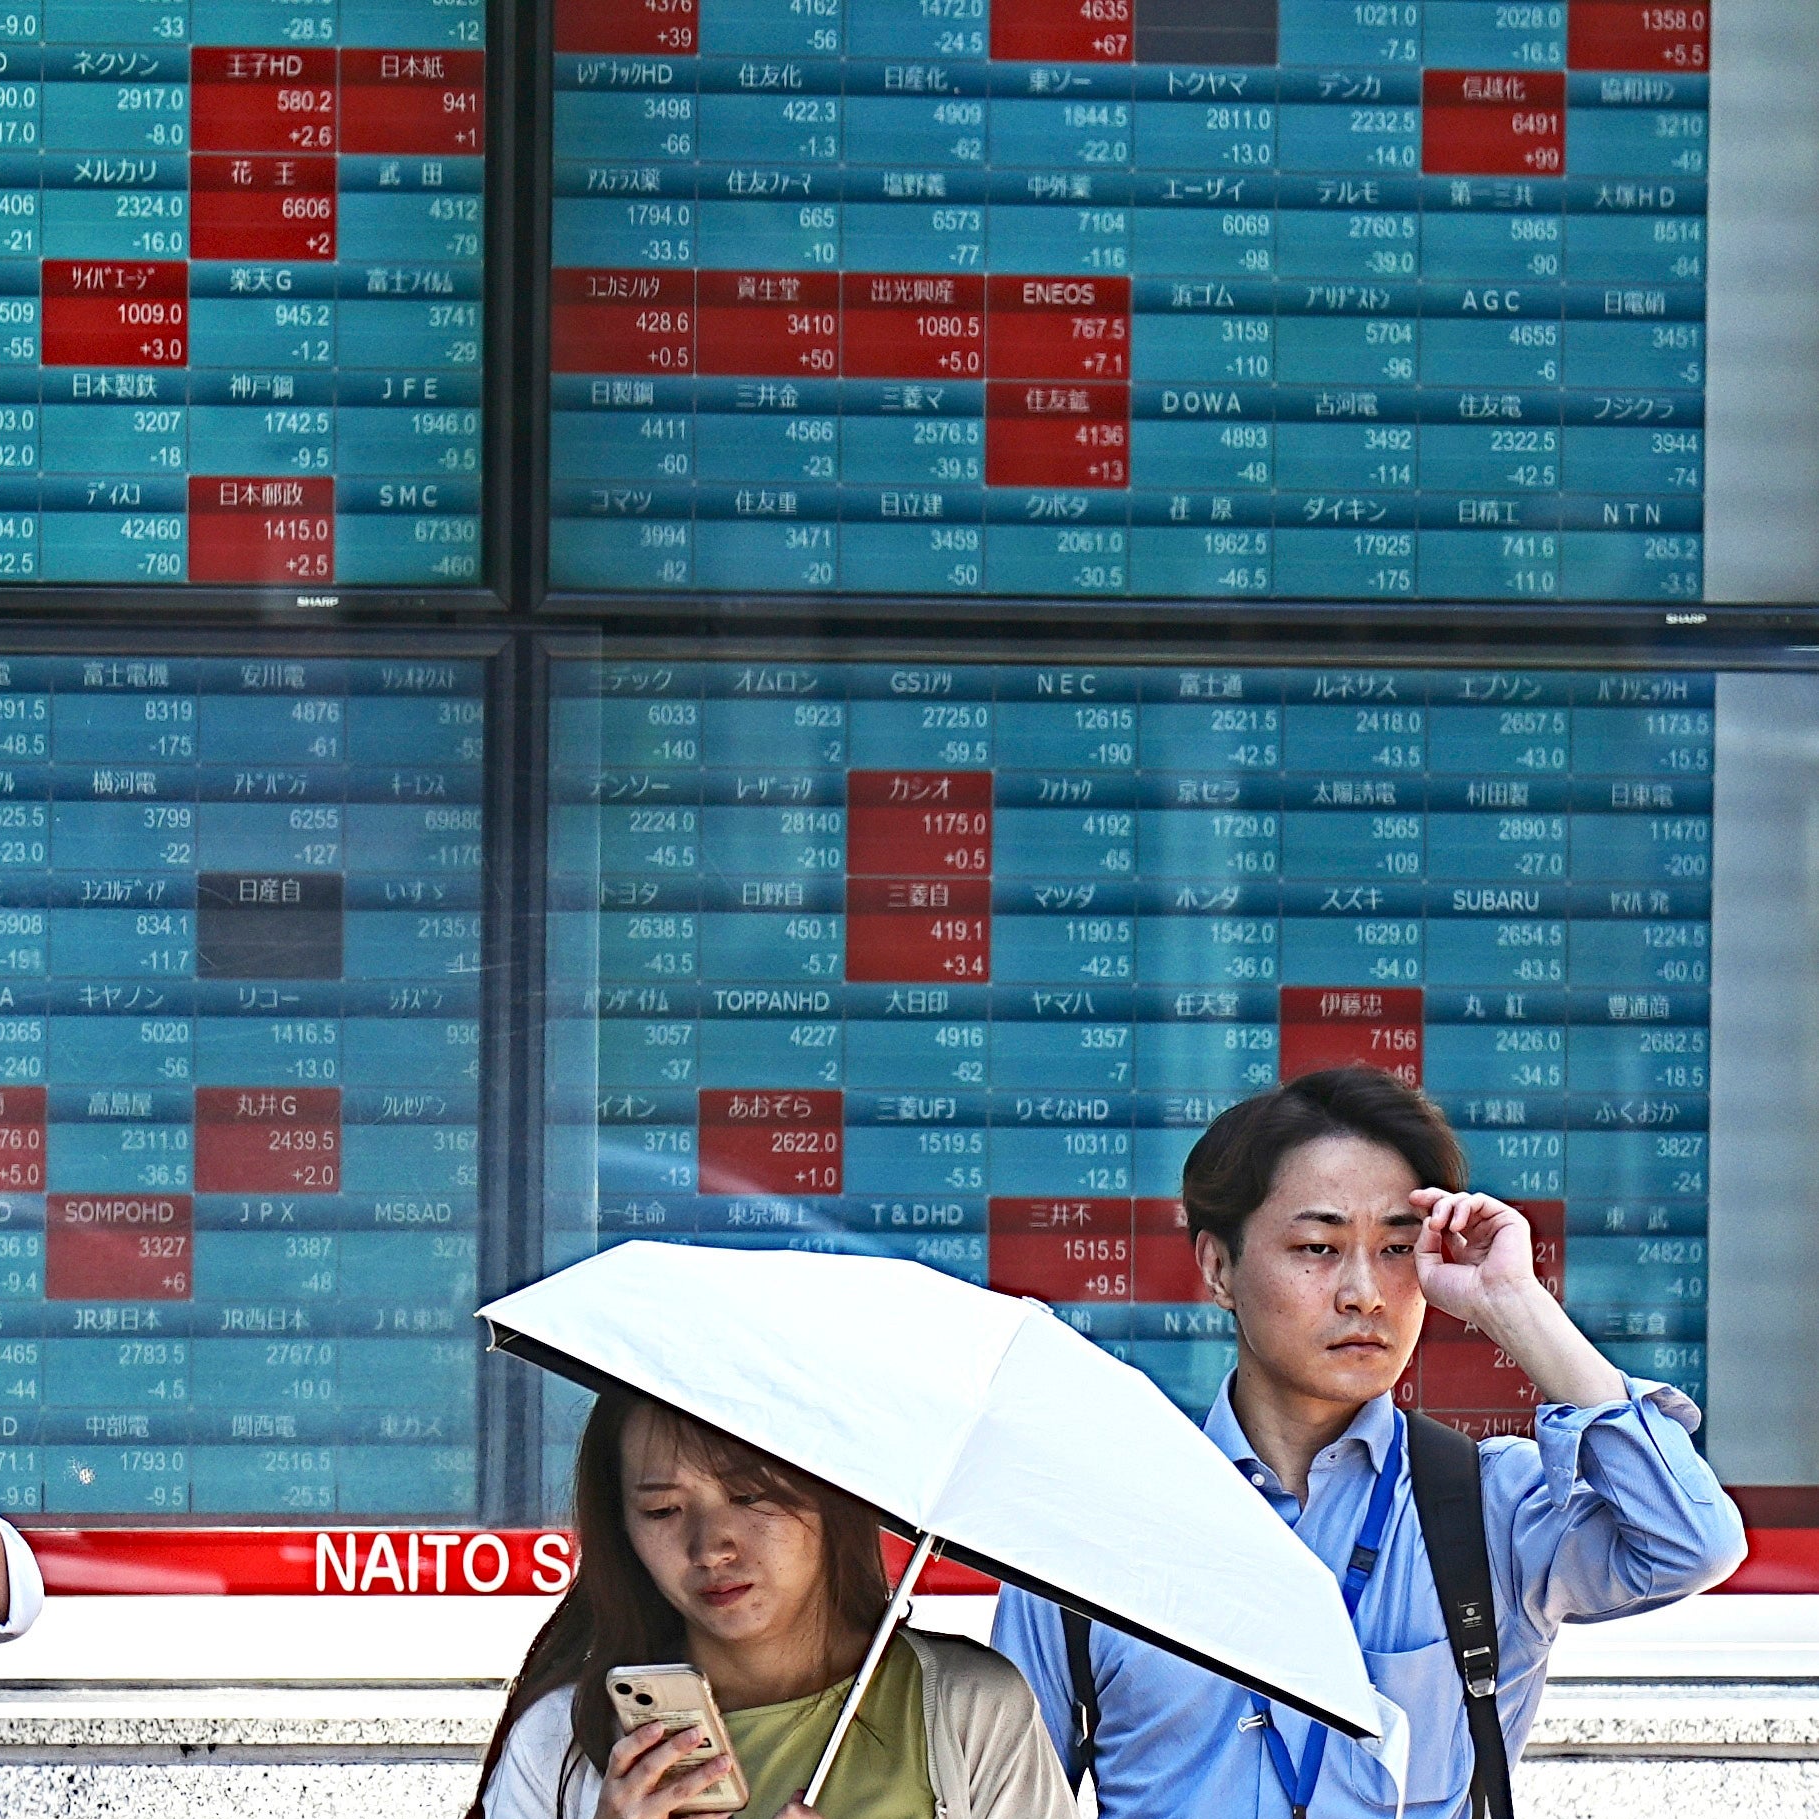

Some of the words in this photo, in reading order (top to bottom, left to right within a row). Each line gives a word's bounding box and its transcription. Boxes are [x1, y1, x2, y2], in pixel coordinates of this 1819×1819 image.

[0, 15, 36, 36] -9.0
[282, 18, 332, 40] -28.5
[657, 27, 691, 46] +39
[934, 32, 983, 54] -24.5
[1092, 35, 1127, 54] +67
[73, 51, 158, 74] ネクソン
[229, 55, 302, 76] 王子HD
[381, 56, 444, 78] 日本紙
[739, 64, 802, 87] 住友化
[1169, 69, 1247, 94] トクヤマ
[117, 84, 185, 110] 2917.0
[443, 92, 475, 112] 941
[783, 101, 836, 122] 422.3
[1207, 108, 1271, 130] 2811.0
[1512, 113, 1556, 134] 6491
[146, 124, 183, 145] -8.0
[289, 126, 331, 146] +2.6
[455, 128, 476, 147] +1
[799, 136, 836, 157] -1.3
[1223, 143, 1271, 164] -13.0
[75, 159, 156, 182] メルカリ
[117, 191, 185, 217] 2324.0
[282, 197, 329, 218] 6606
[628, 204, 689, 226] 1794.0
[800, 207, 835, 228] 665
[4, 229, 32, 251] -21
[133, 232, 182, 252] -16.0
[306, 233, 329, 253] +2
[642, 240, 689, 261] -33.5
[1023, 283, 1095, 304] ENEOS
[118, 303, 181, 324] 1009.0
[636, 312, 688, 332] 428.6
[788, 314, 834, 335] 3410
[917, 316, 979, 337] 1080.5
[140, 338, 181, 358] +3.0
[292, 340, 329, 361] -1.2
[648, 347, 688, 366] +0.5
[799, 349, 834, 369] +50
[938, 351, 979, 371] +5.0
[1537, 360, 1556, 381] -6
[134, 411, 181, 432] 3207
[265, 412, 328, 433] 1742.5
[786, 421, 834, 441] 4566
[1491, 431, 1555, 451] 2322.5
[1237, 462, 1268, 483] -48
[1507, 465, 1555, 486] -42.5
[1304, 498, 1386, 520] ダイキン
[121, 514, 183, 539] 42460
[265, 519, 327, 540] 1415.0
[1354, 534, 1410, 556] 17925
[138, 554, 181, 575] -780
[286, 554, 327, 576] +2.5
[1368, 569, 1410, 591] -175
[735, 668, 817, 691] オムロン
[1075, 708, 1132, 729] 12615
[890, 778, 951, 799] カシオ
[290, 808, 338, 829] 6255
[923, 813, 985, 834] 1175.0
[160, 843, 190, 864] -22
[294, 844, 337, 865] -127
[944, 848, 985, 869] +0.5
[239, 879, 300, 902] 日産自
[1036, 884, 1095, 907] マツダ
[1454, 890, 1539, 910] SUBARU
[136, 911, 193, 935] 834.1
[931, 920, 981, 941] 419.1
[943, 955, 982, 975] +3.4
[714, 990, 830, 1011] TOPPANHD
[1033, 991, 1094, 1013] ヤマハ
[141, 1021, 189, 1043] 5020
[271, 1022, 335, 1044] 1416.5
[790, 1025, 838, 1046] 4227
[1081, 1027, 1128, 1048] 3357
[237, 1095, 296, 1115] 丸井G
[729, 1096, 811, 1118] あおぞら
[1017, 1098, 1109, 1119] りそなHD
[269, 1130, 333, 1151] 2439.5
[772, 1132, 836, 1152] 2622.0
[1064, 1133, 1127, 1154] 1031.0
[292, 1165, 333, 1185] +2.0
[795, 1167, 836, 1186] +1.0
[1079, 1168, 1127, 1190] -12.5
[65, 1202, 173, 1223] SOMPOHD
[1031, 1204, 1091, 1226] 三井不
[139, 1236, 186, 1258] 3327
[1064, 1240, 1126, 1260] 1515.5
[162, 1272, 185, 1291] +6
[1086, 1275, 1126, 1294] +9.5
[74, 1308, 160, 1329] JR東日本
[221, 1308, 309, 1329] JR西日本
[86, 1415, 149, 1437] 中部電
[232, 1415, 296, 1437] 関西電
[316, 1532, 510, 1593] NAITO
